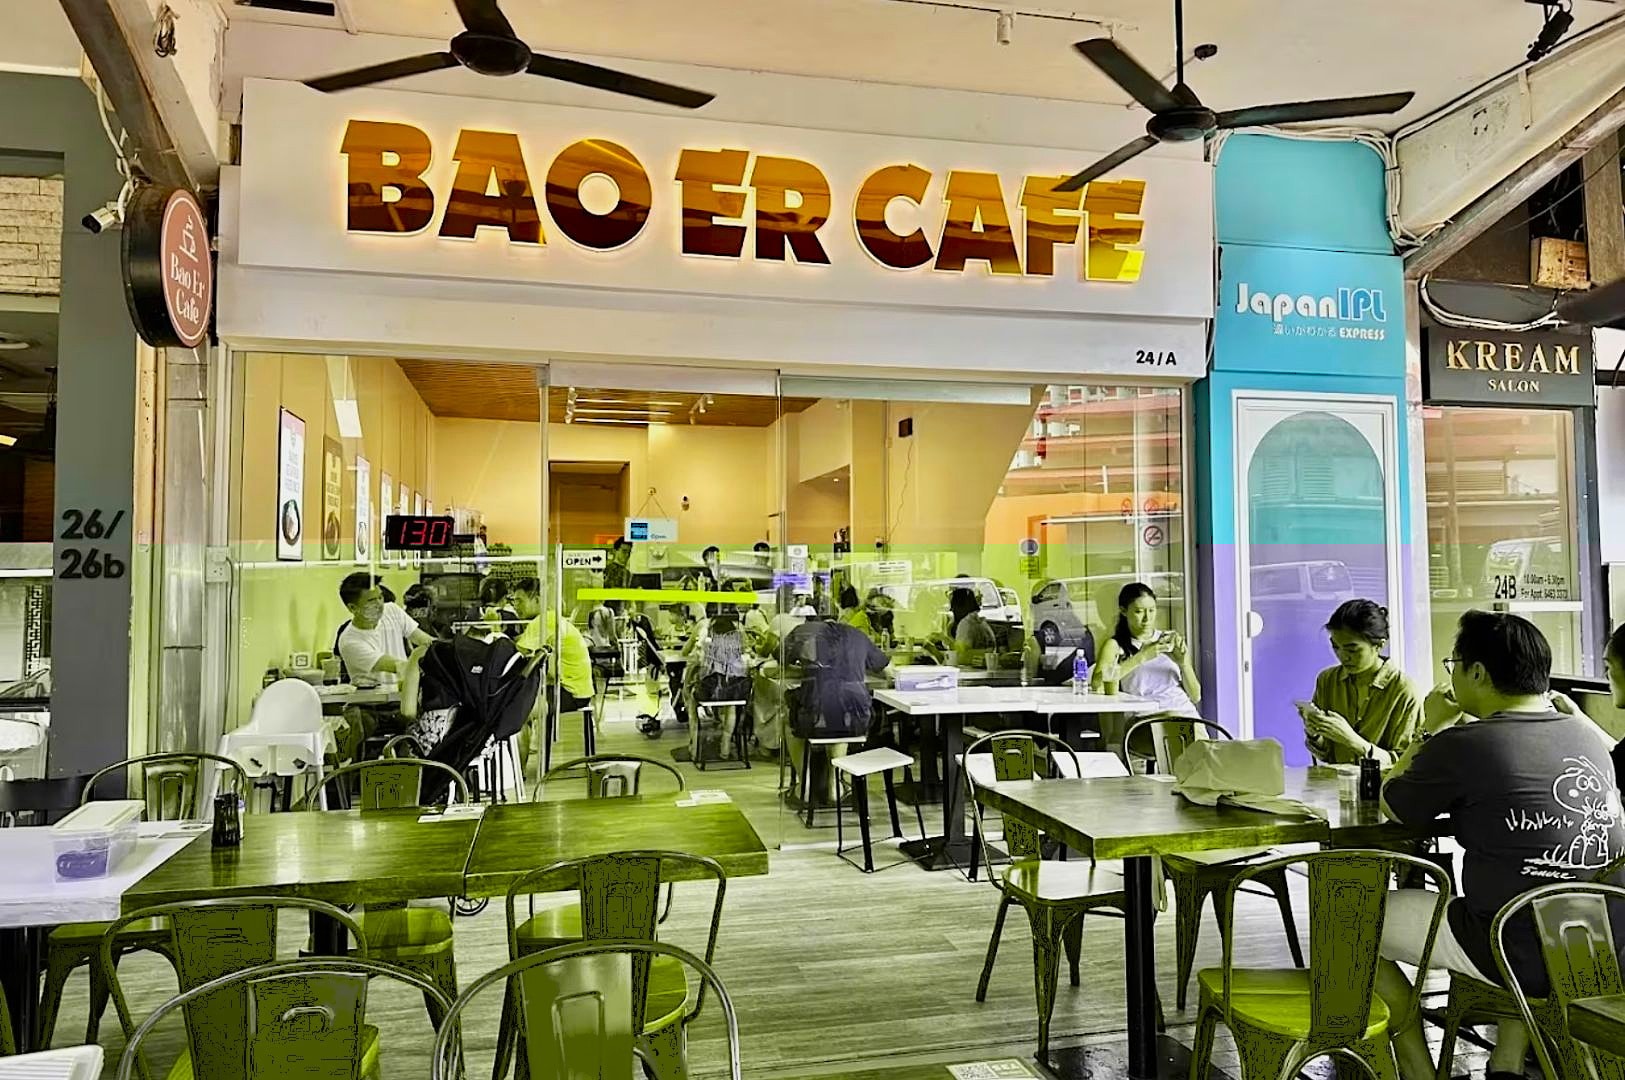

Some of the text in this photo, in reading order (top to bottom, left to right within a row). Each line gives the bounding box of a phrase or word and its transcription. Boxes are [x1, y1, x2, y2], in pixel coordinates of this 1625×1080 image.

[340, 119, 1146, 282] BAO ER CAFE
[170, 252, 205, 298] Bao Er
[175, 288, 199, 324] Cafe
[1339, 327, 1385, 341] EXPRESS
[1446, 340, 1581, 375] KREAM
[1488, 379, 1540, 393] SALON
[60, 509, 125, 540] 26/
[59, 548, 125, 579] 26b
[566, 558, 591, 566] OPEN
[1494, 575, 1516, 599] 24B
